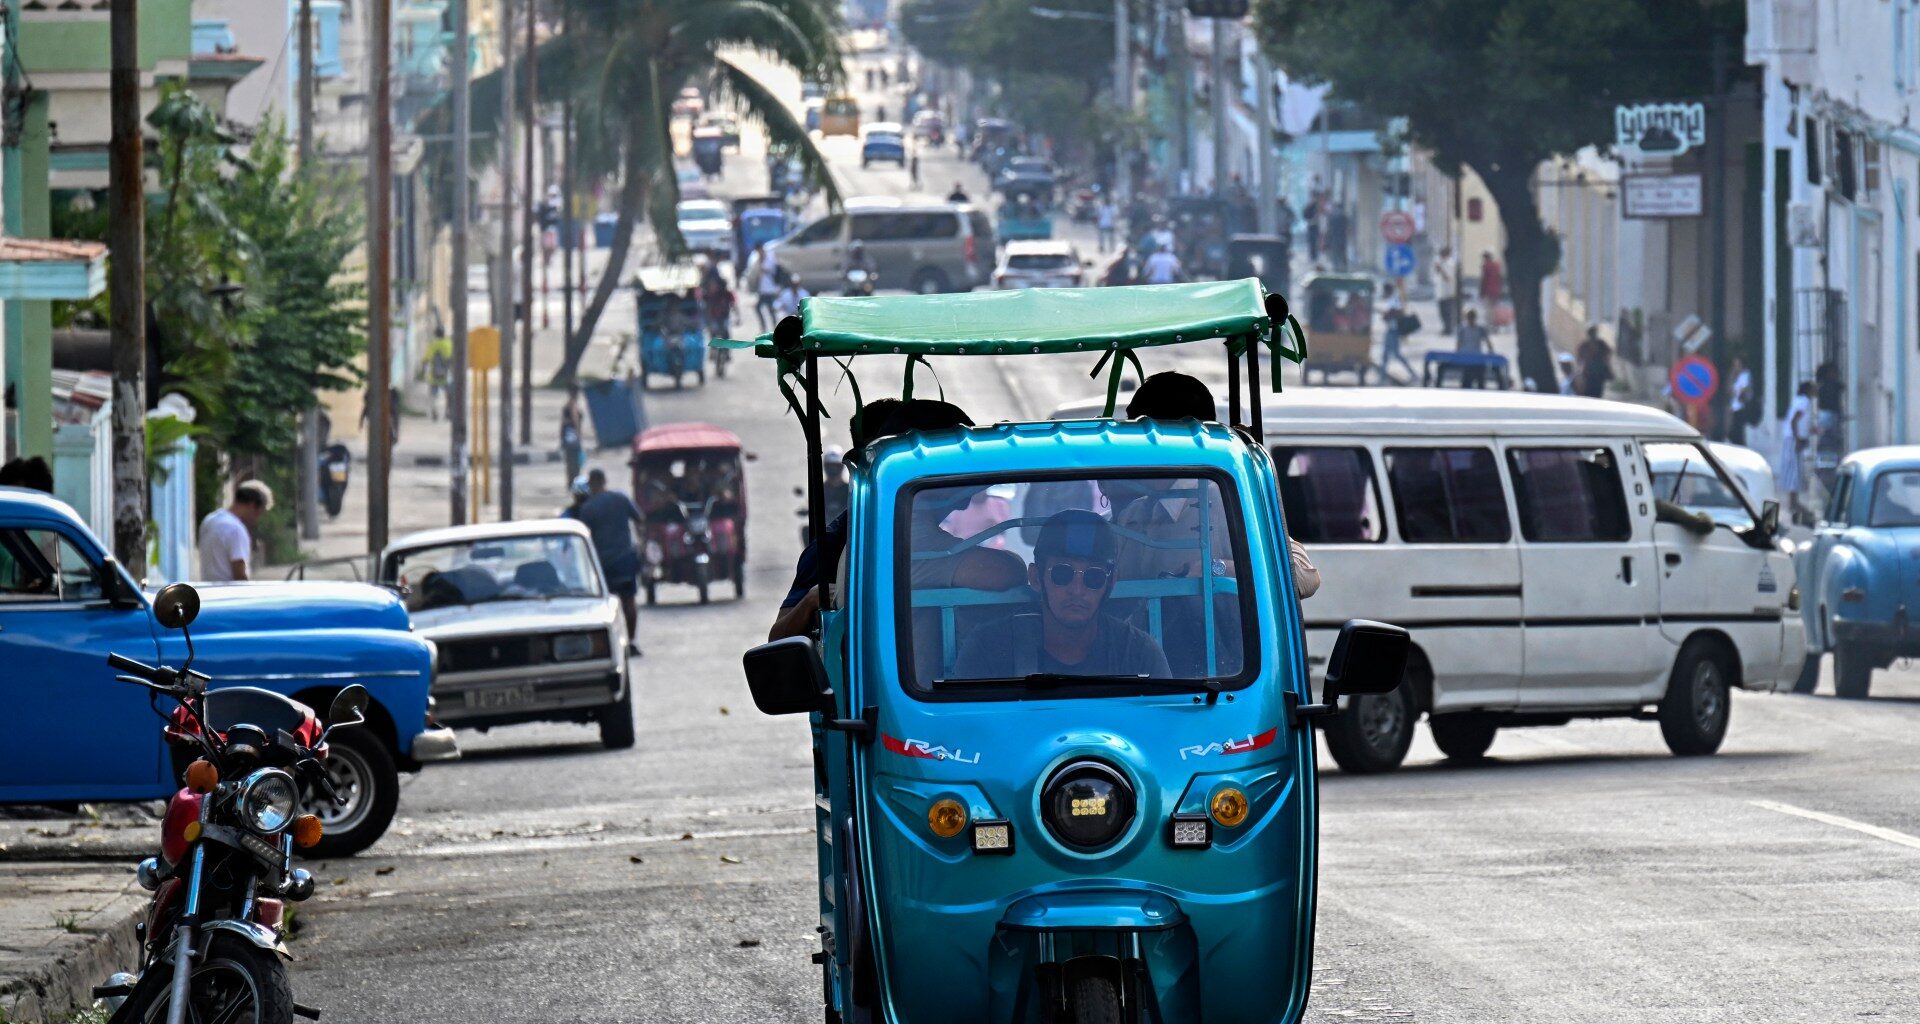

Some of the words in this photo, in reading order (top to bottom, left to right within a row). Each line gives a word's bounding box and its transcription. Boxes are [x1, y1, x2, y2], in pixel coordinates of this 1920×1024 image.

[1623, 443, 1648, 517] H100
[904, 738, 981, 764] RALI
[1180, 733, 1255, 760] RALI
